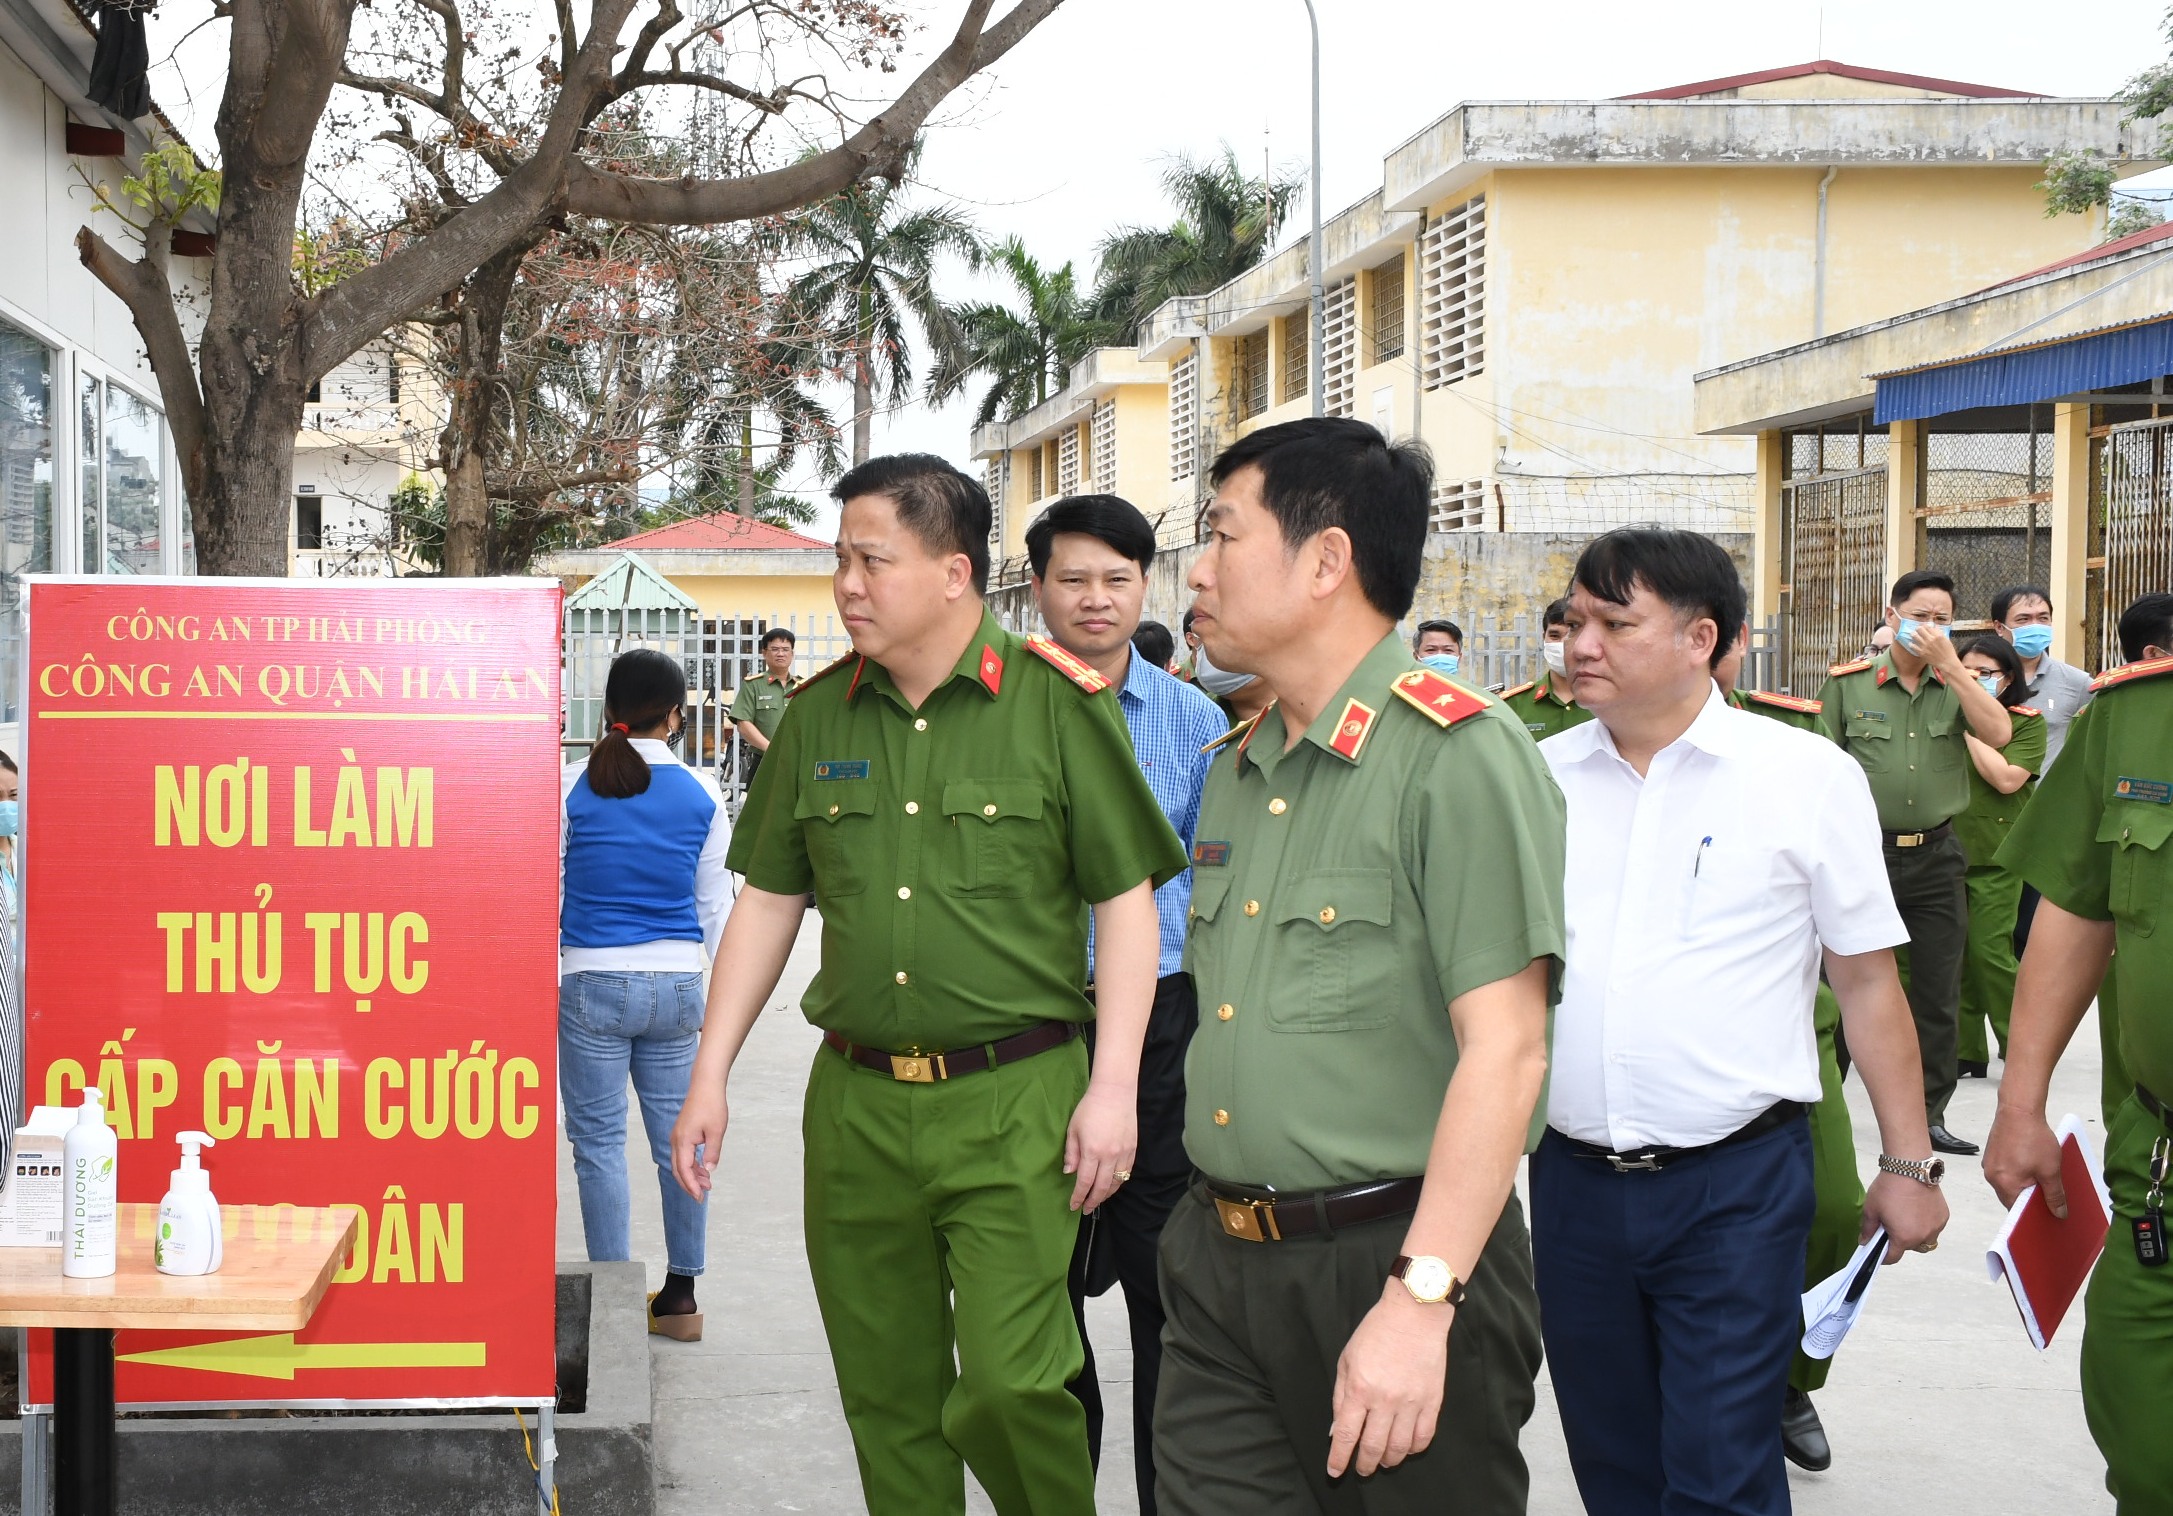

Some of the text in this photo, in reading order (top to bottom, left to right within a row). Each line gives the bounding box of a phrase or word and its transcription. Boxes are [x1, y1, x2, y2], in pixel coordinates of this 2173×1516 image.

[107, 607, 486, 643] CÔNG AN TP HẢI PHÒNG
[39, 653, 550, 708] CÔNG AN QUẬN HẢI AN
[155, 749, 433, 847] NƠI LÀM
[157, 883, 429, 1012] THỦ TỤC
[46, 1028, 539, 1139] CẤP CĂN CƯỚC
